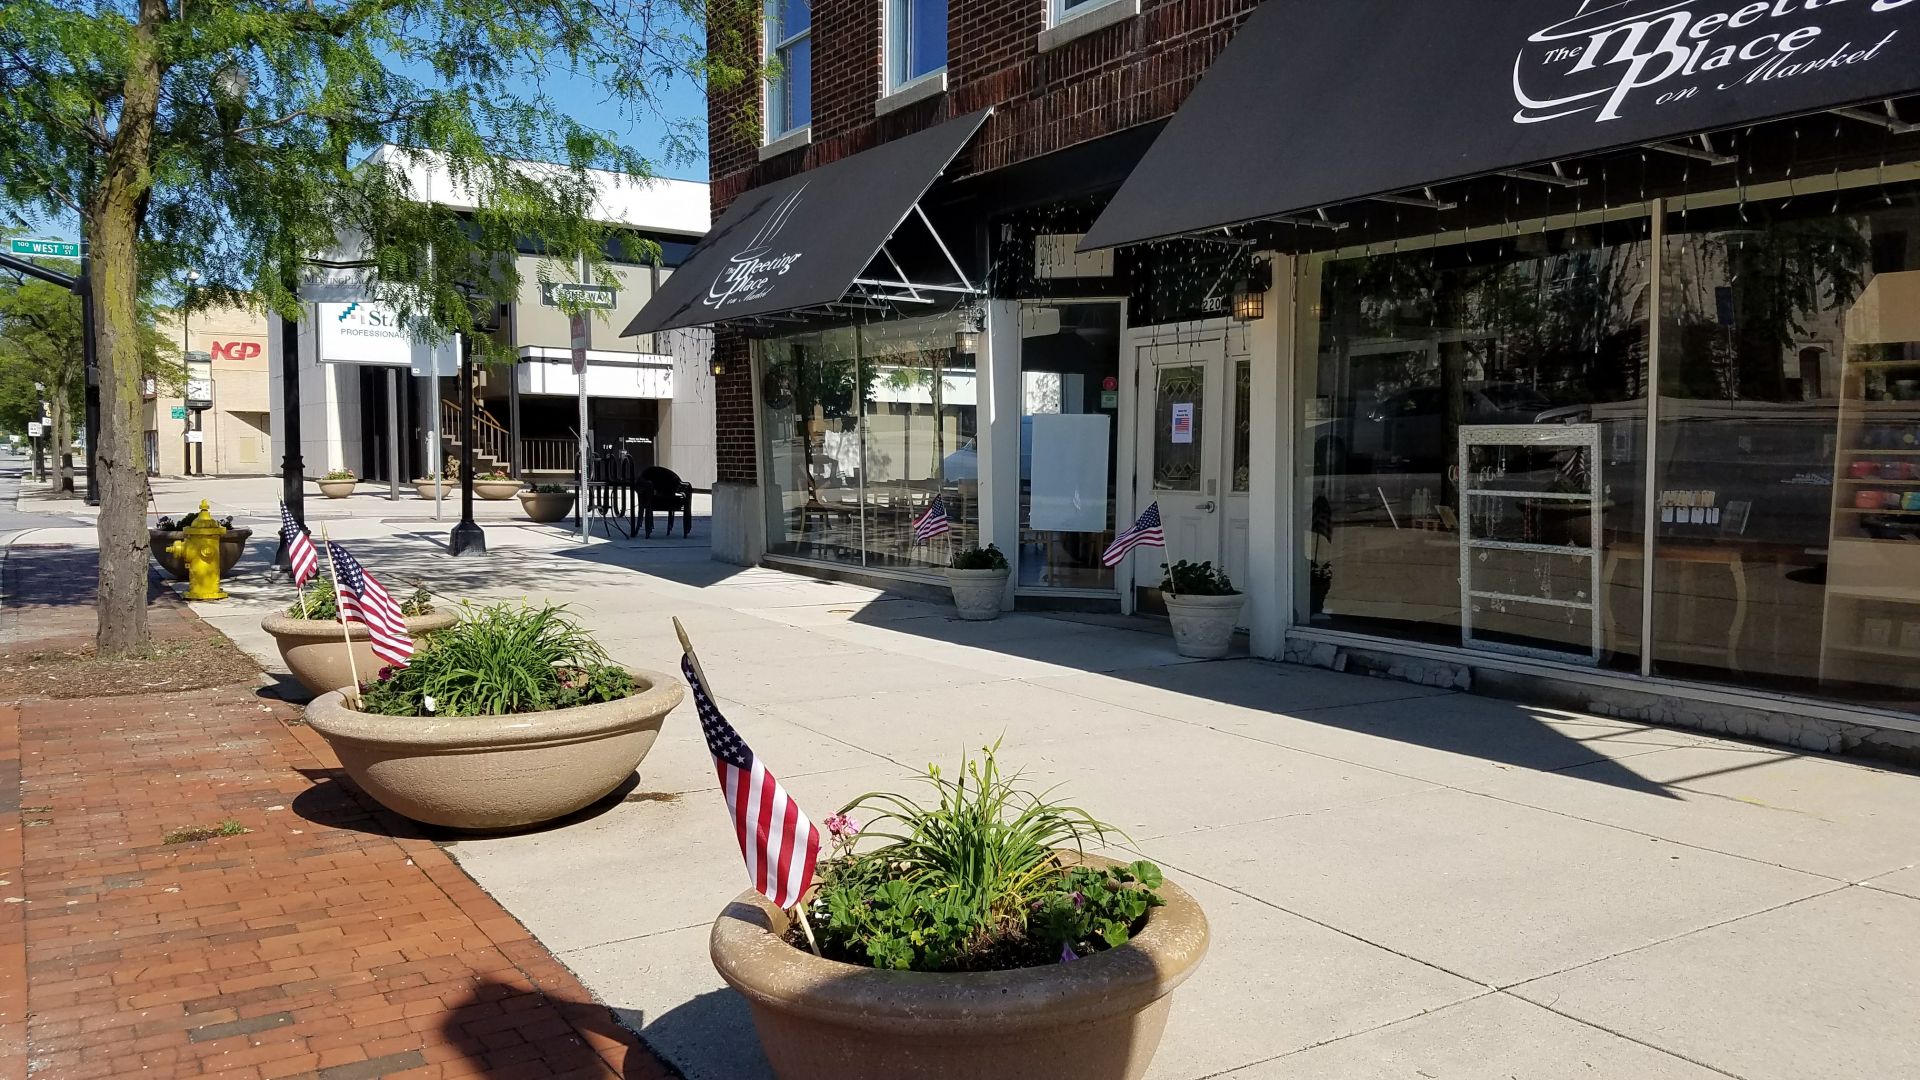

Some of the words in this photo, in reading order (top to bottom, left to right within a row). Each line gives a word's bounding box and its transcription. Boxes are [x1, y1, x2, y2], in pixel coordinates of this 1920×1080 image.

[1564, 0, 1919, 75] Meet
[1542, 46, 1583, 66] The
[1655, 86, 1700, 105] on
[1717, 29, 1900, 89] Market
[1595, 26, 1822, 122] Place
[33, 243, 59, 254] WEST
[724, 253, 802, 283] Meeting
[714, 275, 768, 310] Place
[1203, 297, 1221, 311] 220
[340, 328, 405, 339] PROFESSIONAL
